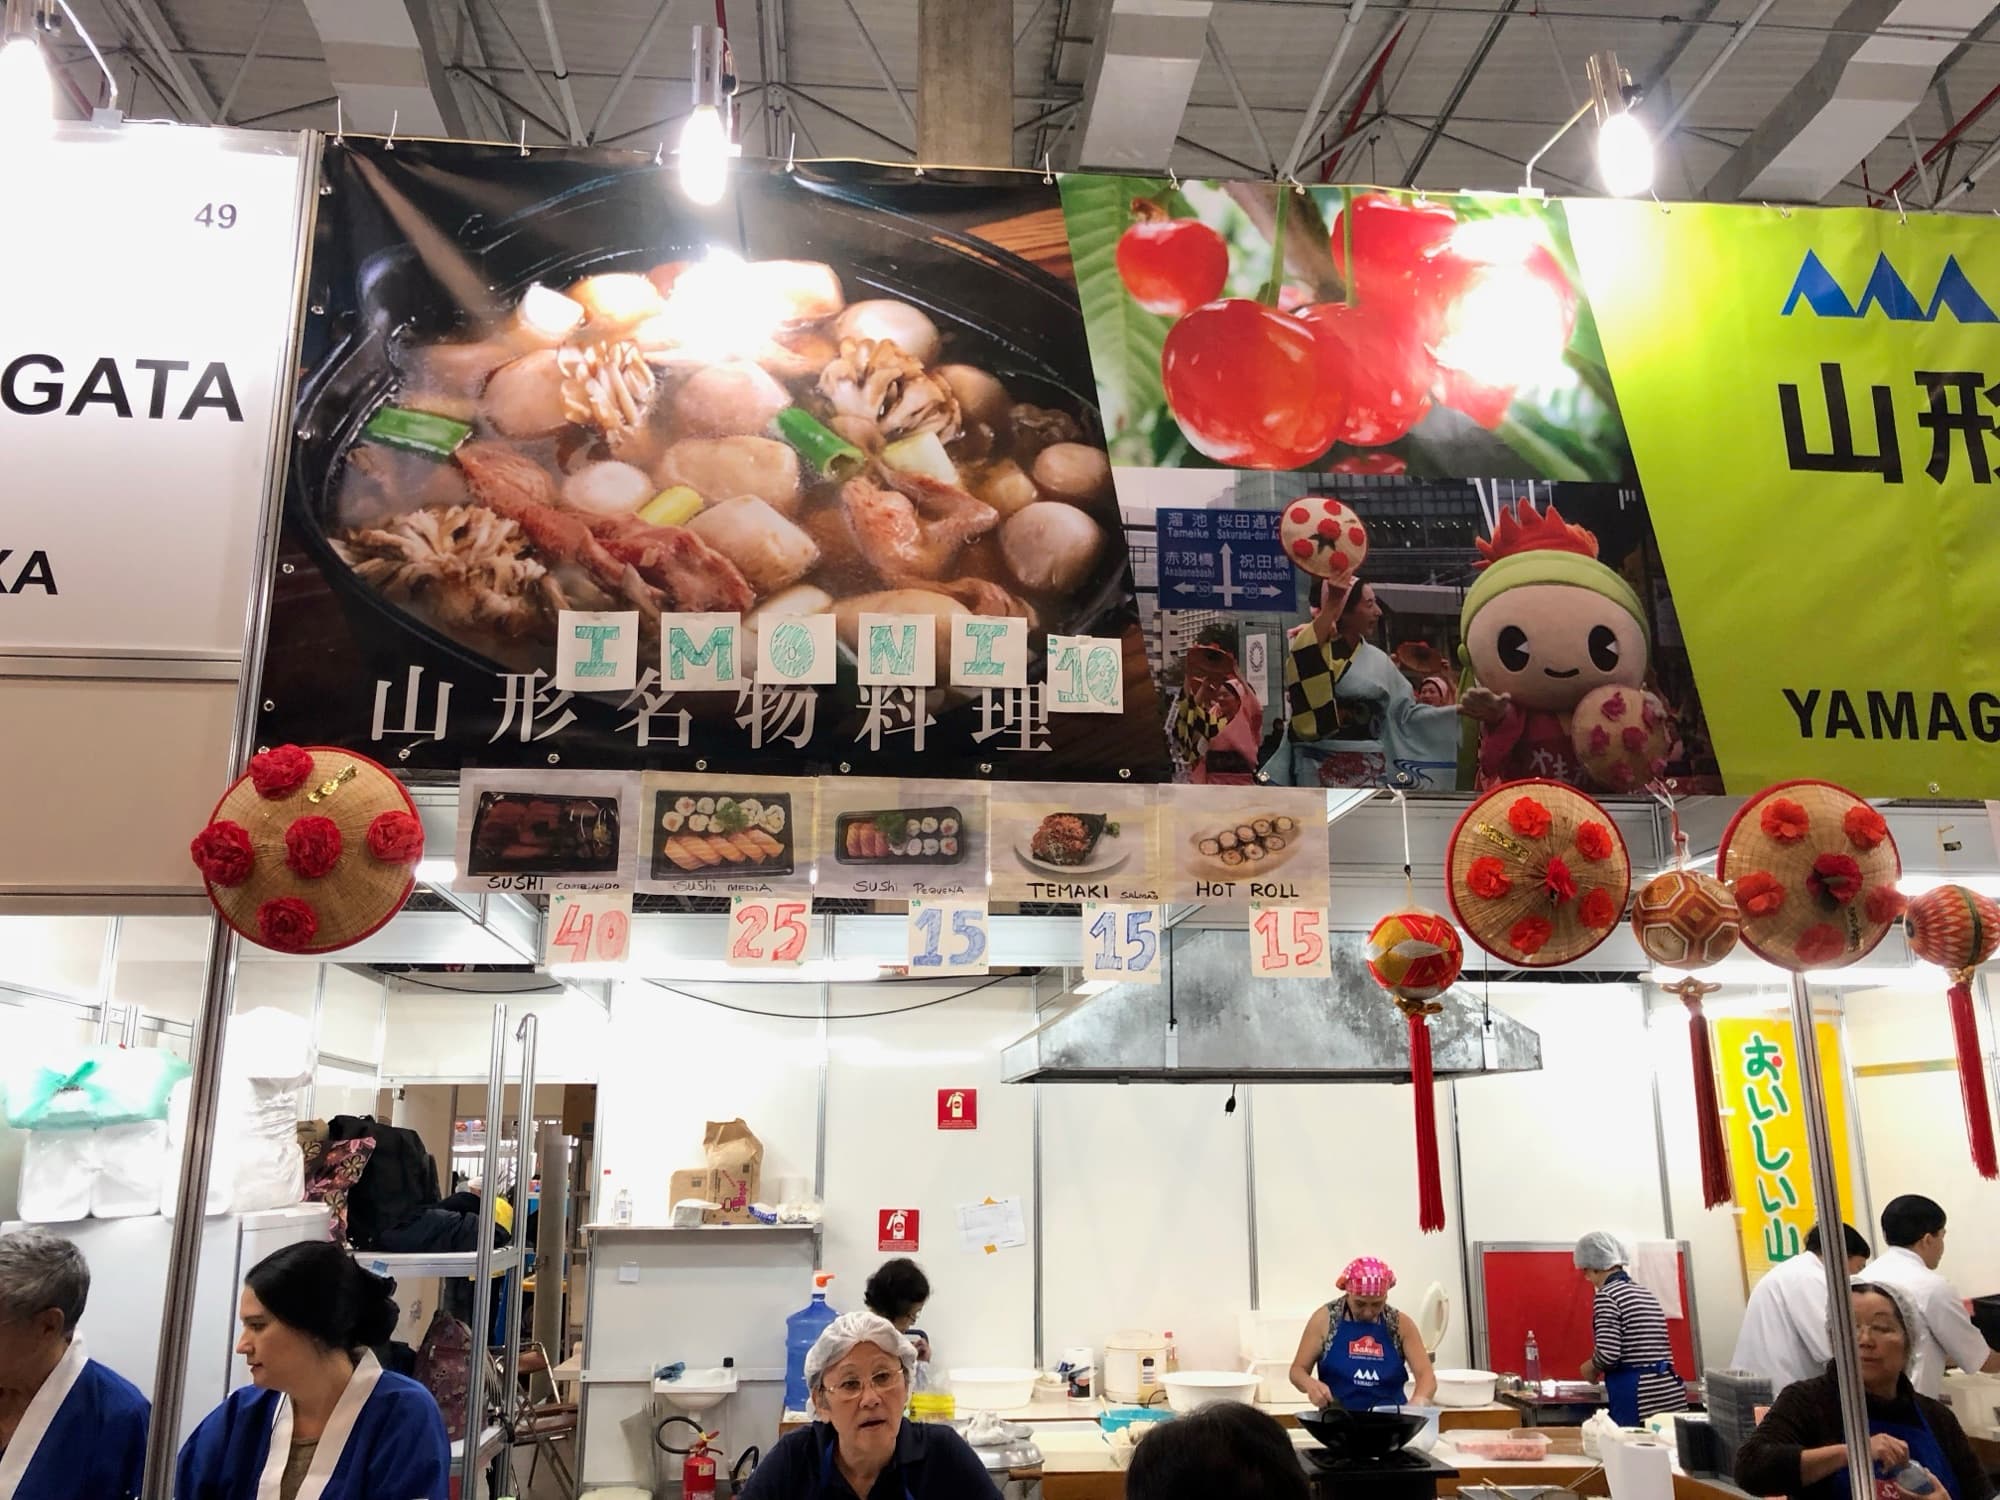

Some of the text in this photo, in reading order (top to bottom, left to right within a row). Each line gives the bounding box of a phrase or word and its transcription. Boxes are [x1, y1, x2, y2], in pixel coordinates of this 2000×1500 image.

[194, 203, 238, 230] 49
[1, 353, 244, 422] GATA
[1167, 527, 1209, 539] Tameike
[1056, 646, 1120, 705] 10
[1782, 688, 2000, 743] YAMAG
[487, 875, 544, 891] SUSHI
[1026, 882, 1109, 899] TEMAKI
[1196, 881, 1299, 898] HOT ROLL
[553, 904, 628, 963] 40
[733, 903, 807, 961] 25
[912, 908, 986, 967] 15
[1090, 911, 1157, 971] 15
[1254, 911, 1323, 970] 15
